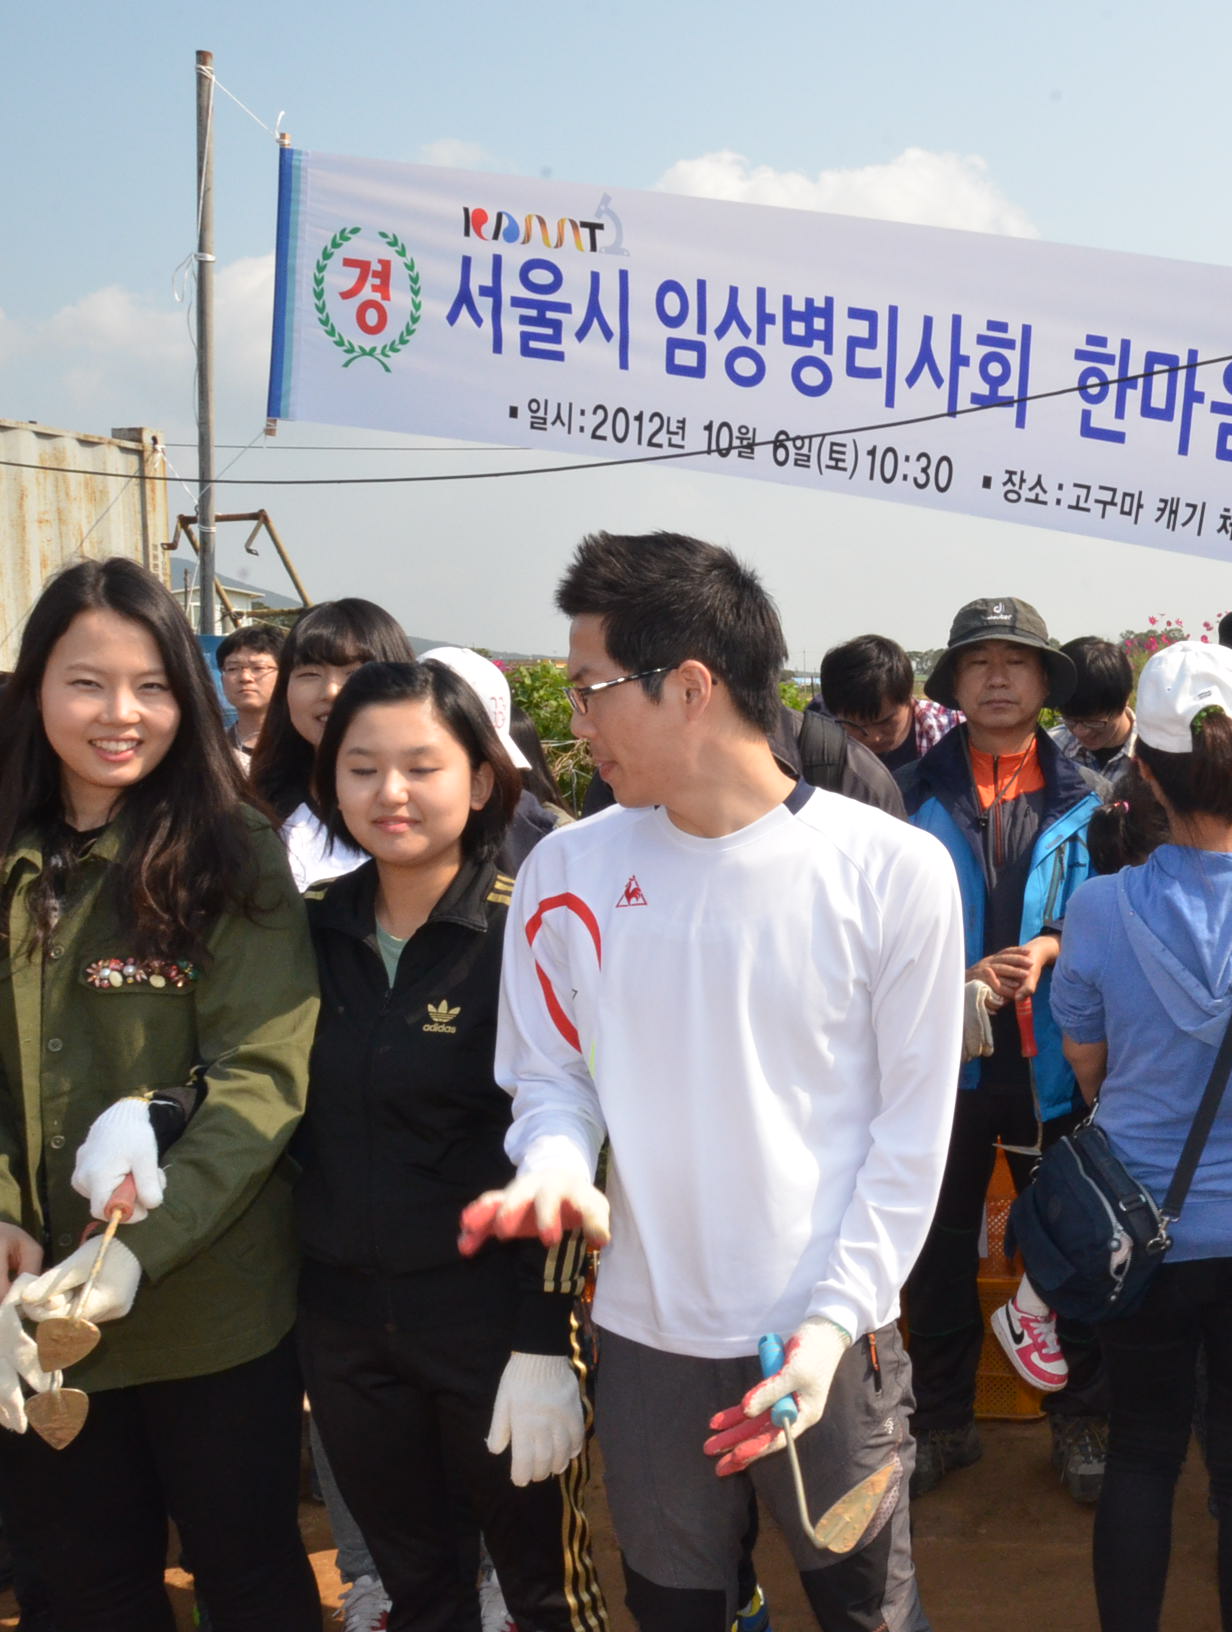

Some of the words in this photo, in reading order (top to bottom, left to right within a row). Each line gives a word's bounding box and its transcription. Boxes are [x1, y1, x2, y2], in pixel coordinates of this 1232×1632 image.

[339, 257, 392, 336] 경
[446, 253, 630, 371] 서울시
[655, 277, 1032, 430] 임상병리사회
[527, 398, 687, 450] 일시:2012년
[702, 419, 757, 460] 10월
[1154, 496, 1207, 537] 캐기
[422, 1022, 457, 1034] adidas
